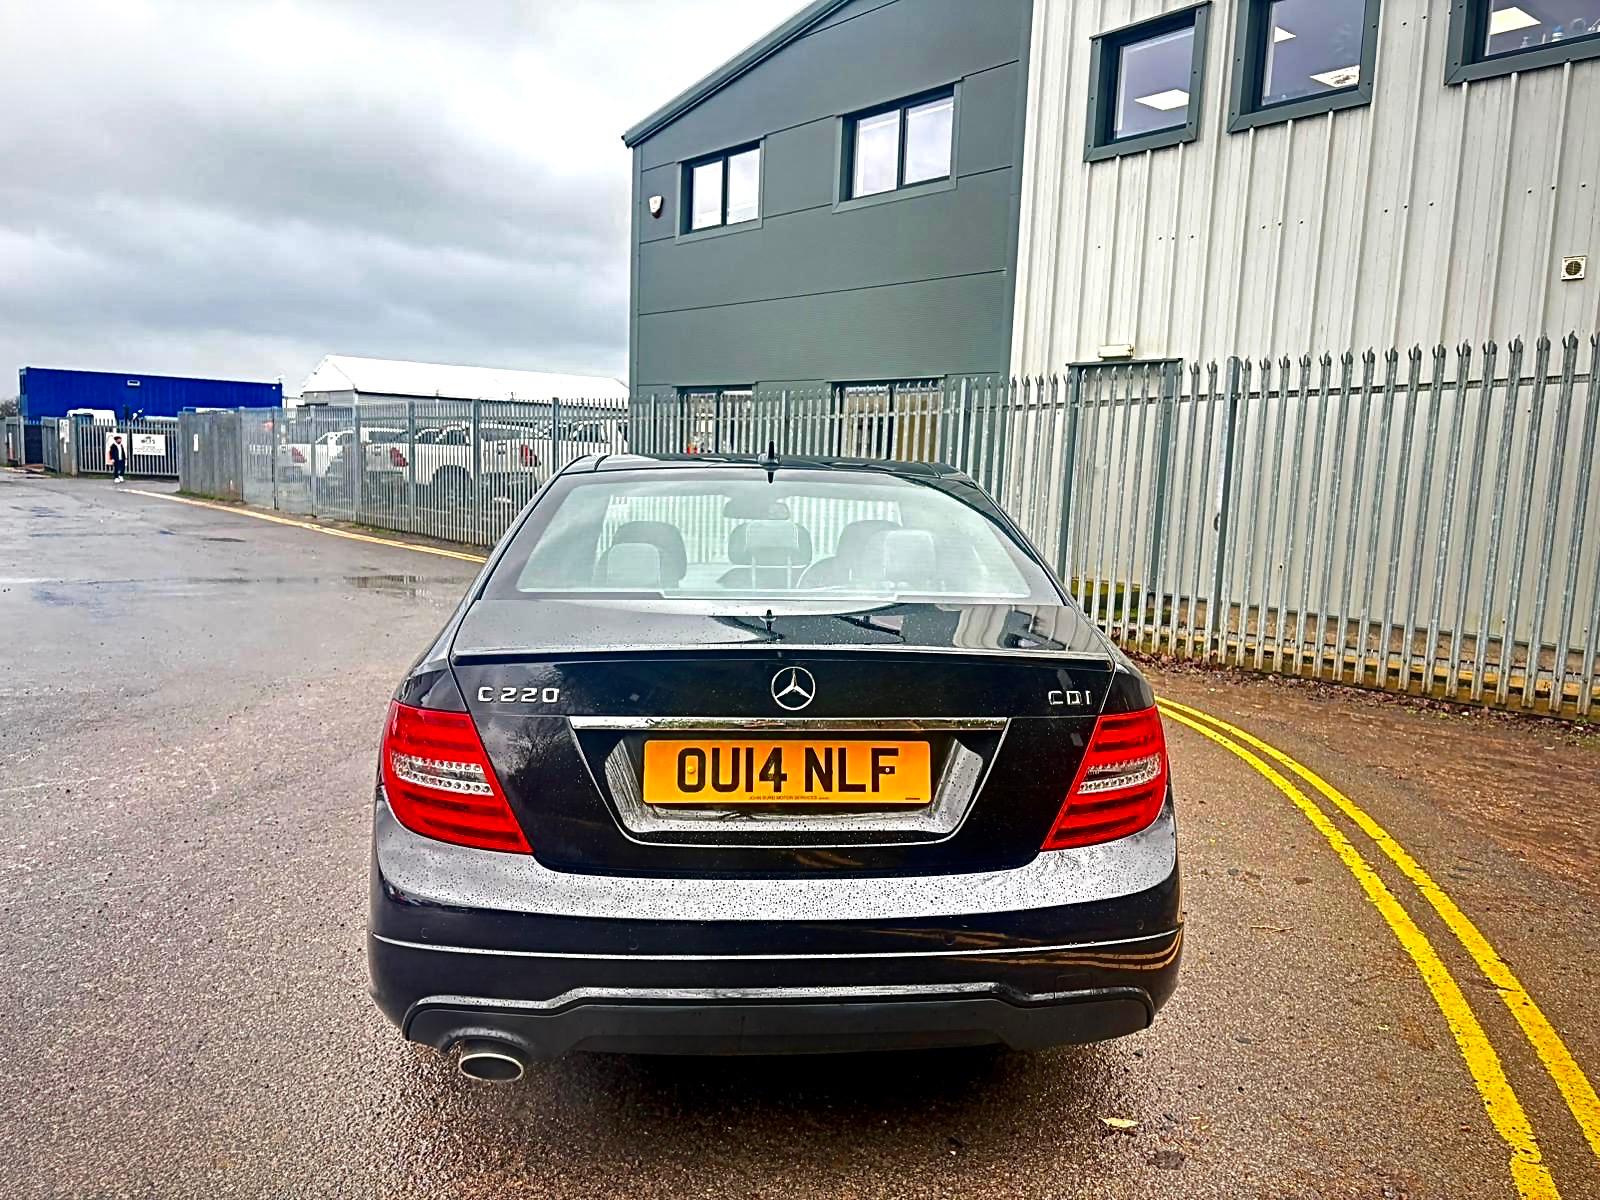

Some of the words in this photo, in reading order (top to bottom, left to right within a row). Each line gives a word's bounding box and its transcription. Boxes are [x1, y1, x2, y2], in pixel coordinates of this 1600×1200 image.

[478, 686, 494, 702] C
[500, 687, 560, 703] 220
[1048, 690, 1092, 705] CDI
[677, 747, 788, 793] OU14
[804, 747, 899, 793] NLF
